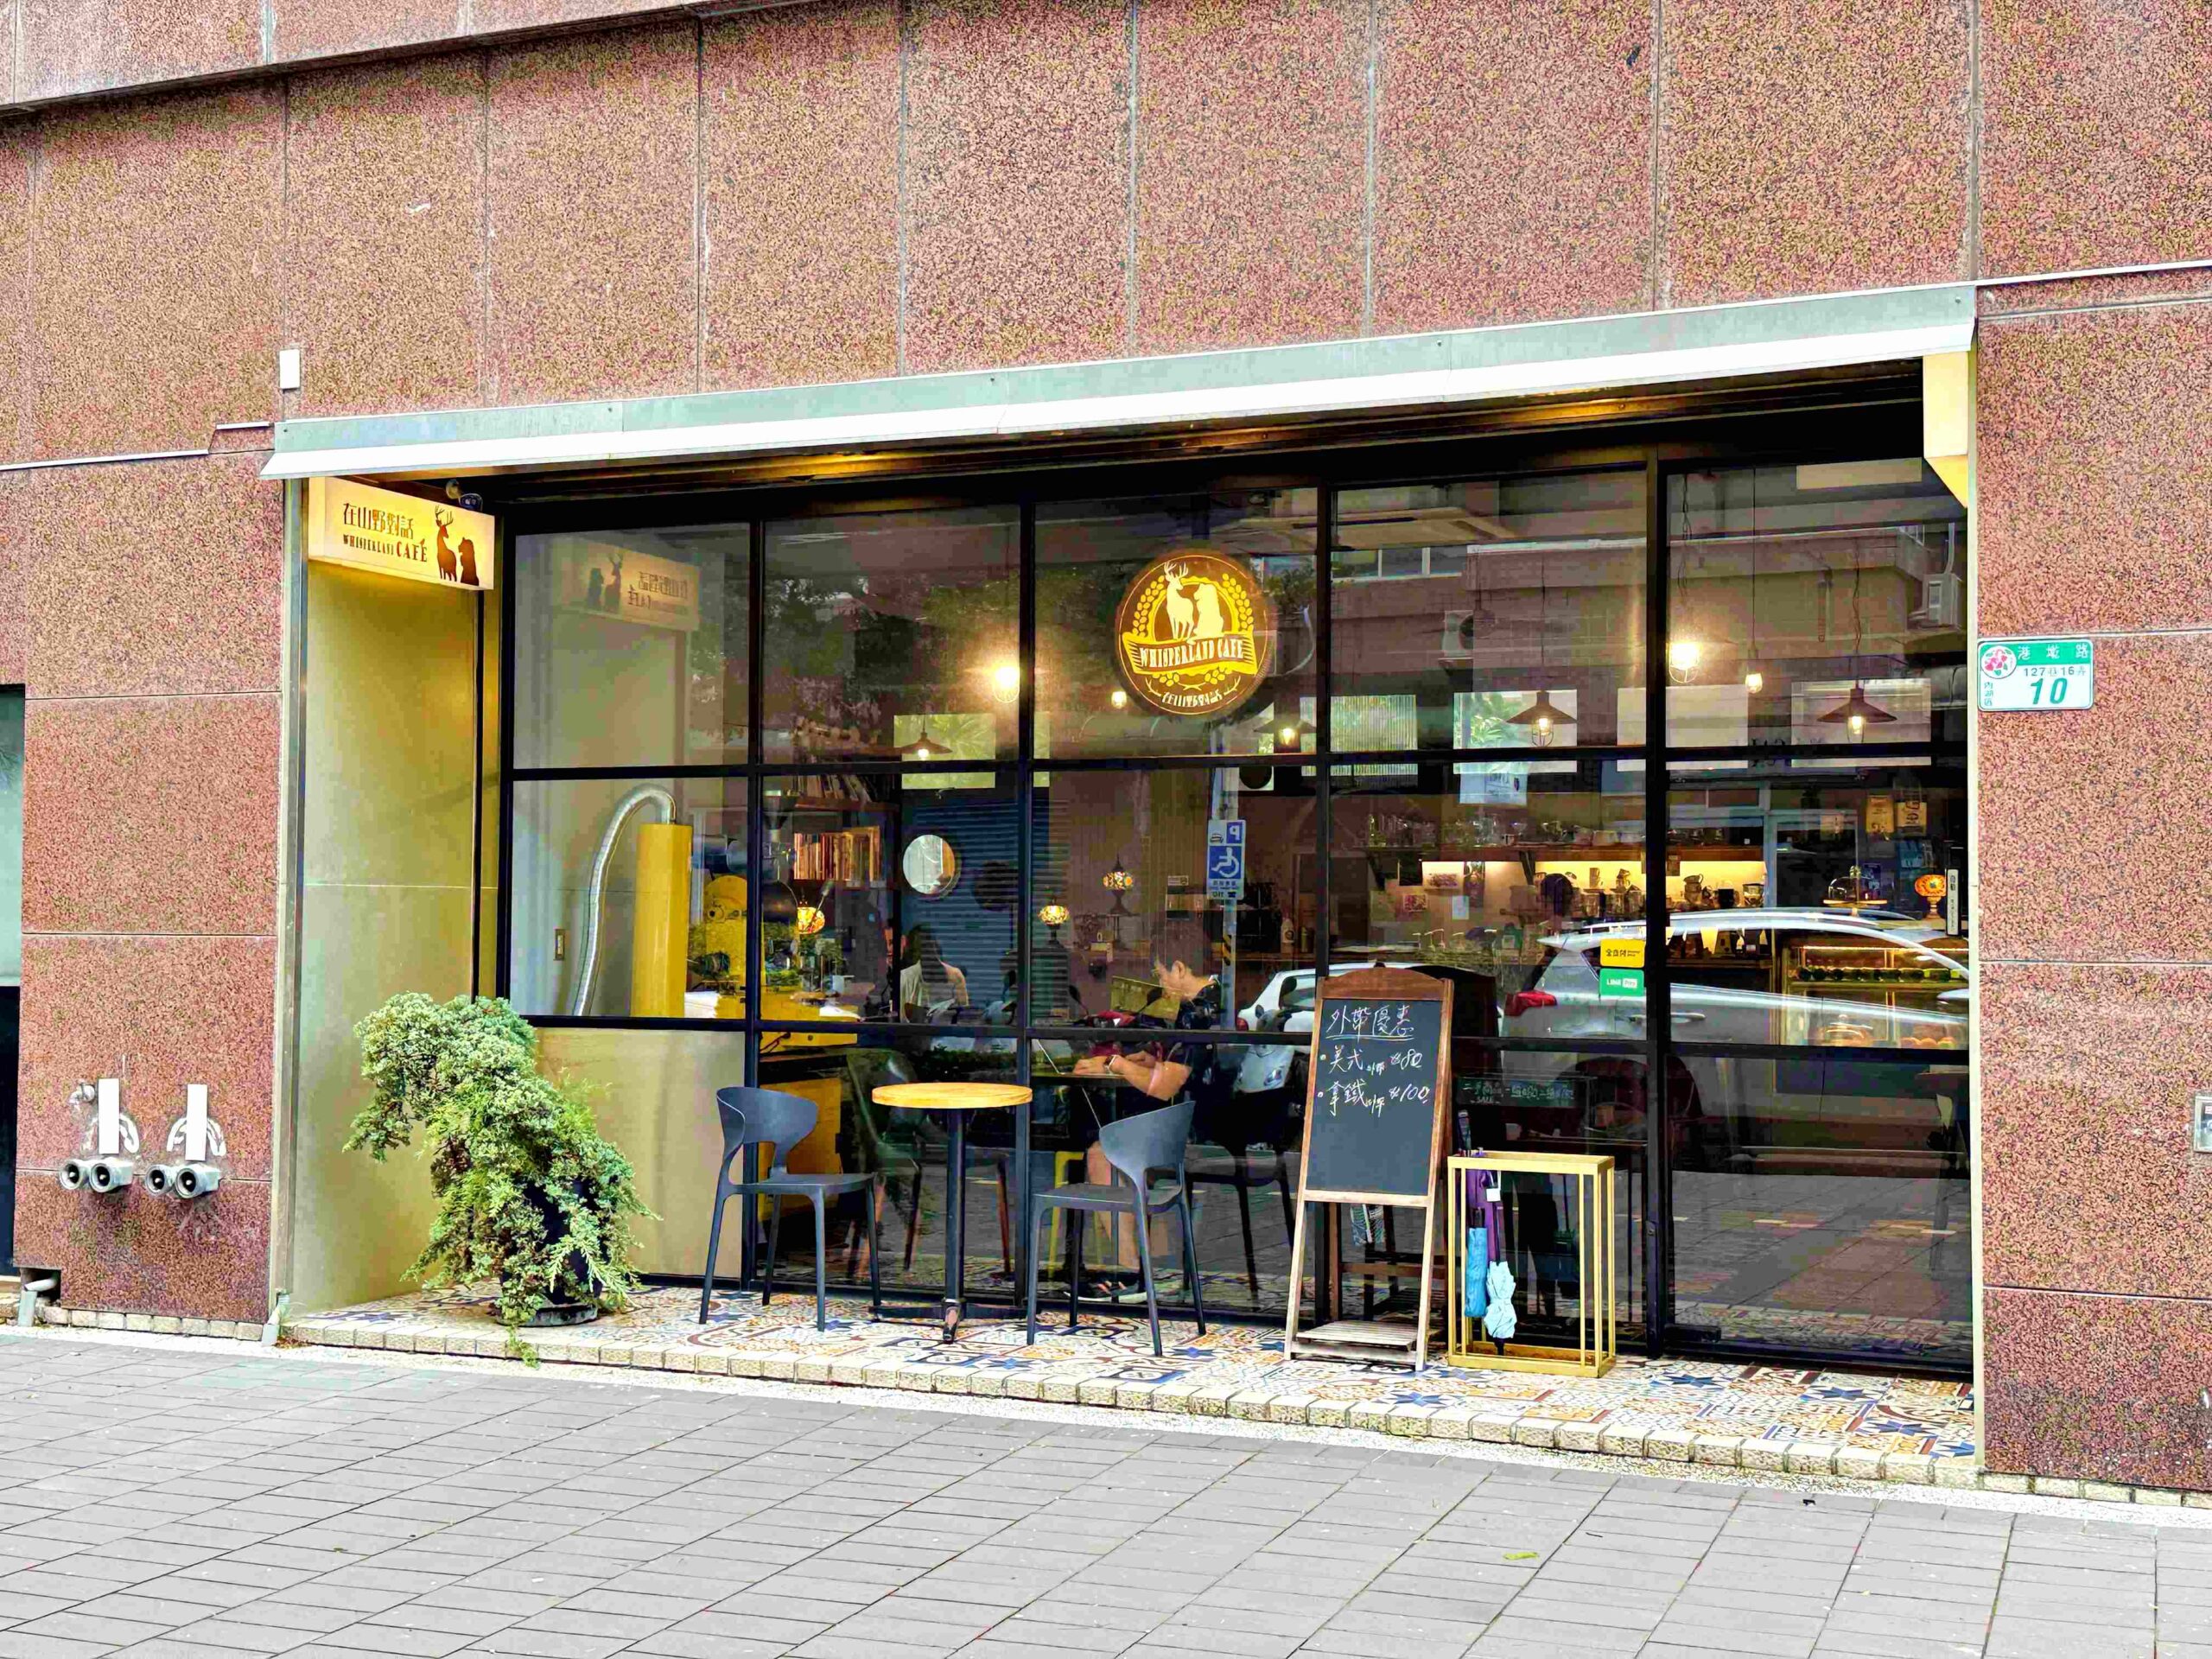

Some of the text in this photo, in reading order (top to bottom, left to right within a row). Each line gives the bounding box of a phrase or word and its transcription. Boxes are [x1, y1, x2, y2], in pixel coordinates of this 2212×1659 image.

[1140, 639, 1215, 668] WHISPERLAND
[2031, 677, 2068, 705] 10
[1326, 1005, 1414, 1039] 外帶優惠
